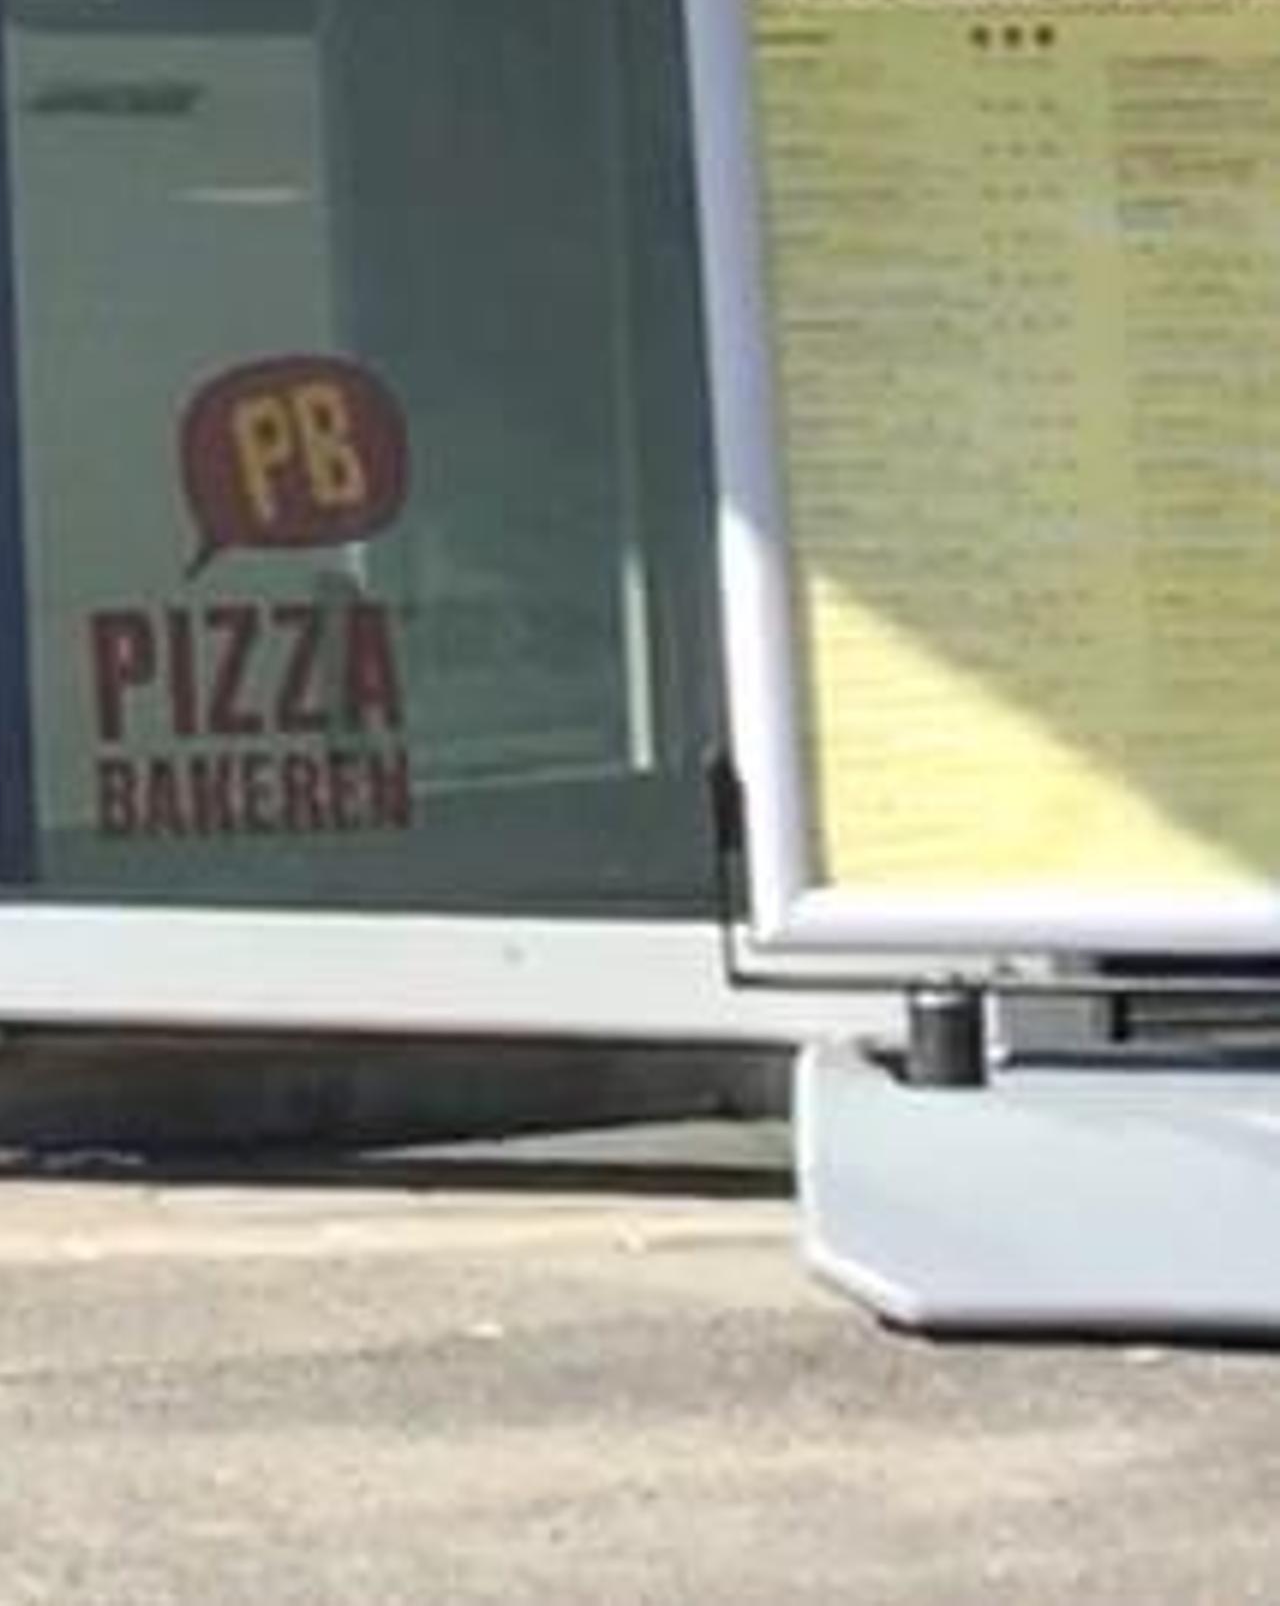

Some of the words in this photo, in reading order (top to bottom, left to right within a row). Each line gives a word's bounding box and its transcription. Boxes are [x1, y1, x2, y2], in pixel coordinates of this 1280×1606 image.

[233, 381, 366, 524] PB
[91, 599, 401, 742] PIZZA
[97, 748, 412, 844] BAKEREN
